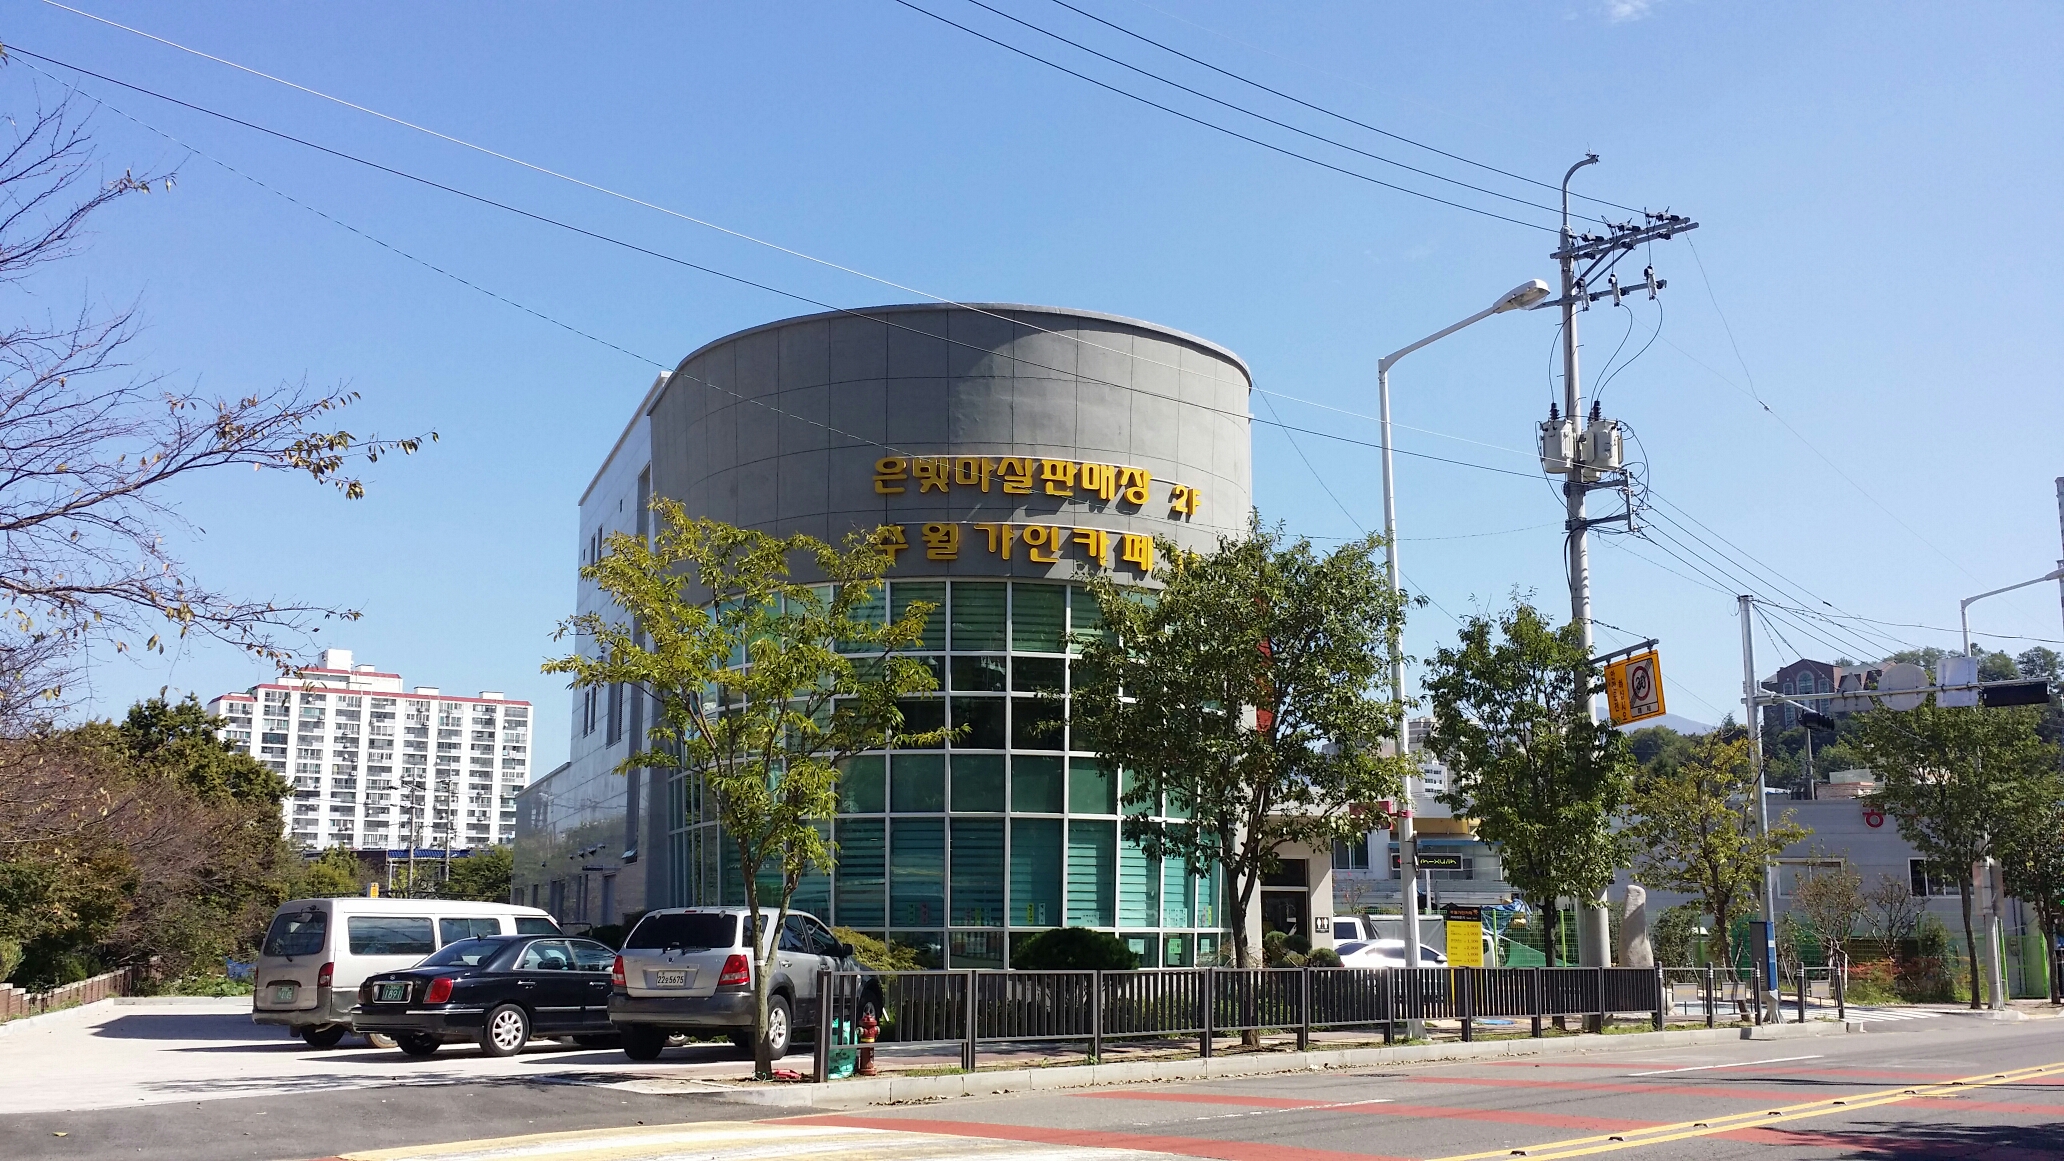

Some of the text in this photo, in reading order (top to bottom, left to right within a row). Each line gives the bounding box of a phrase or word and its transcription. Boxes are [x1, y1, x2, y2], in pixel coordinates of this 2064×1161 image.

[872, 456, 1201, 515] 은빛마실판매장 2F
[384, 989, 402, 999] 1891
